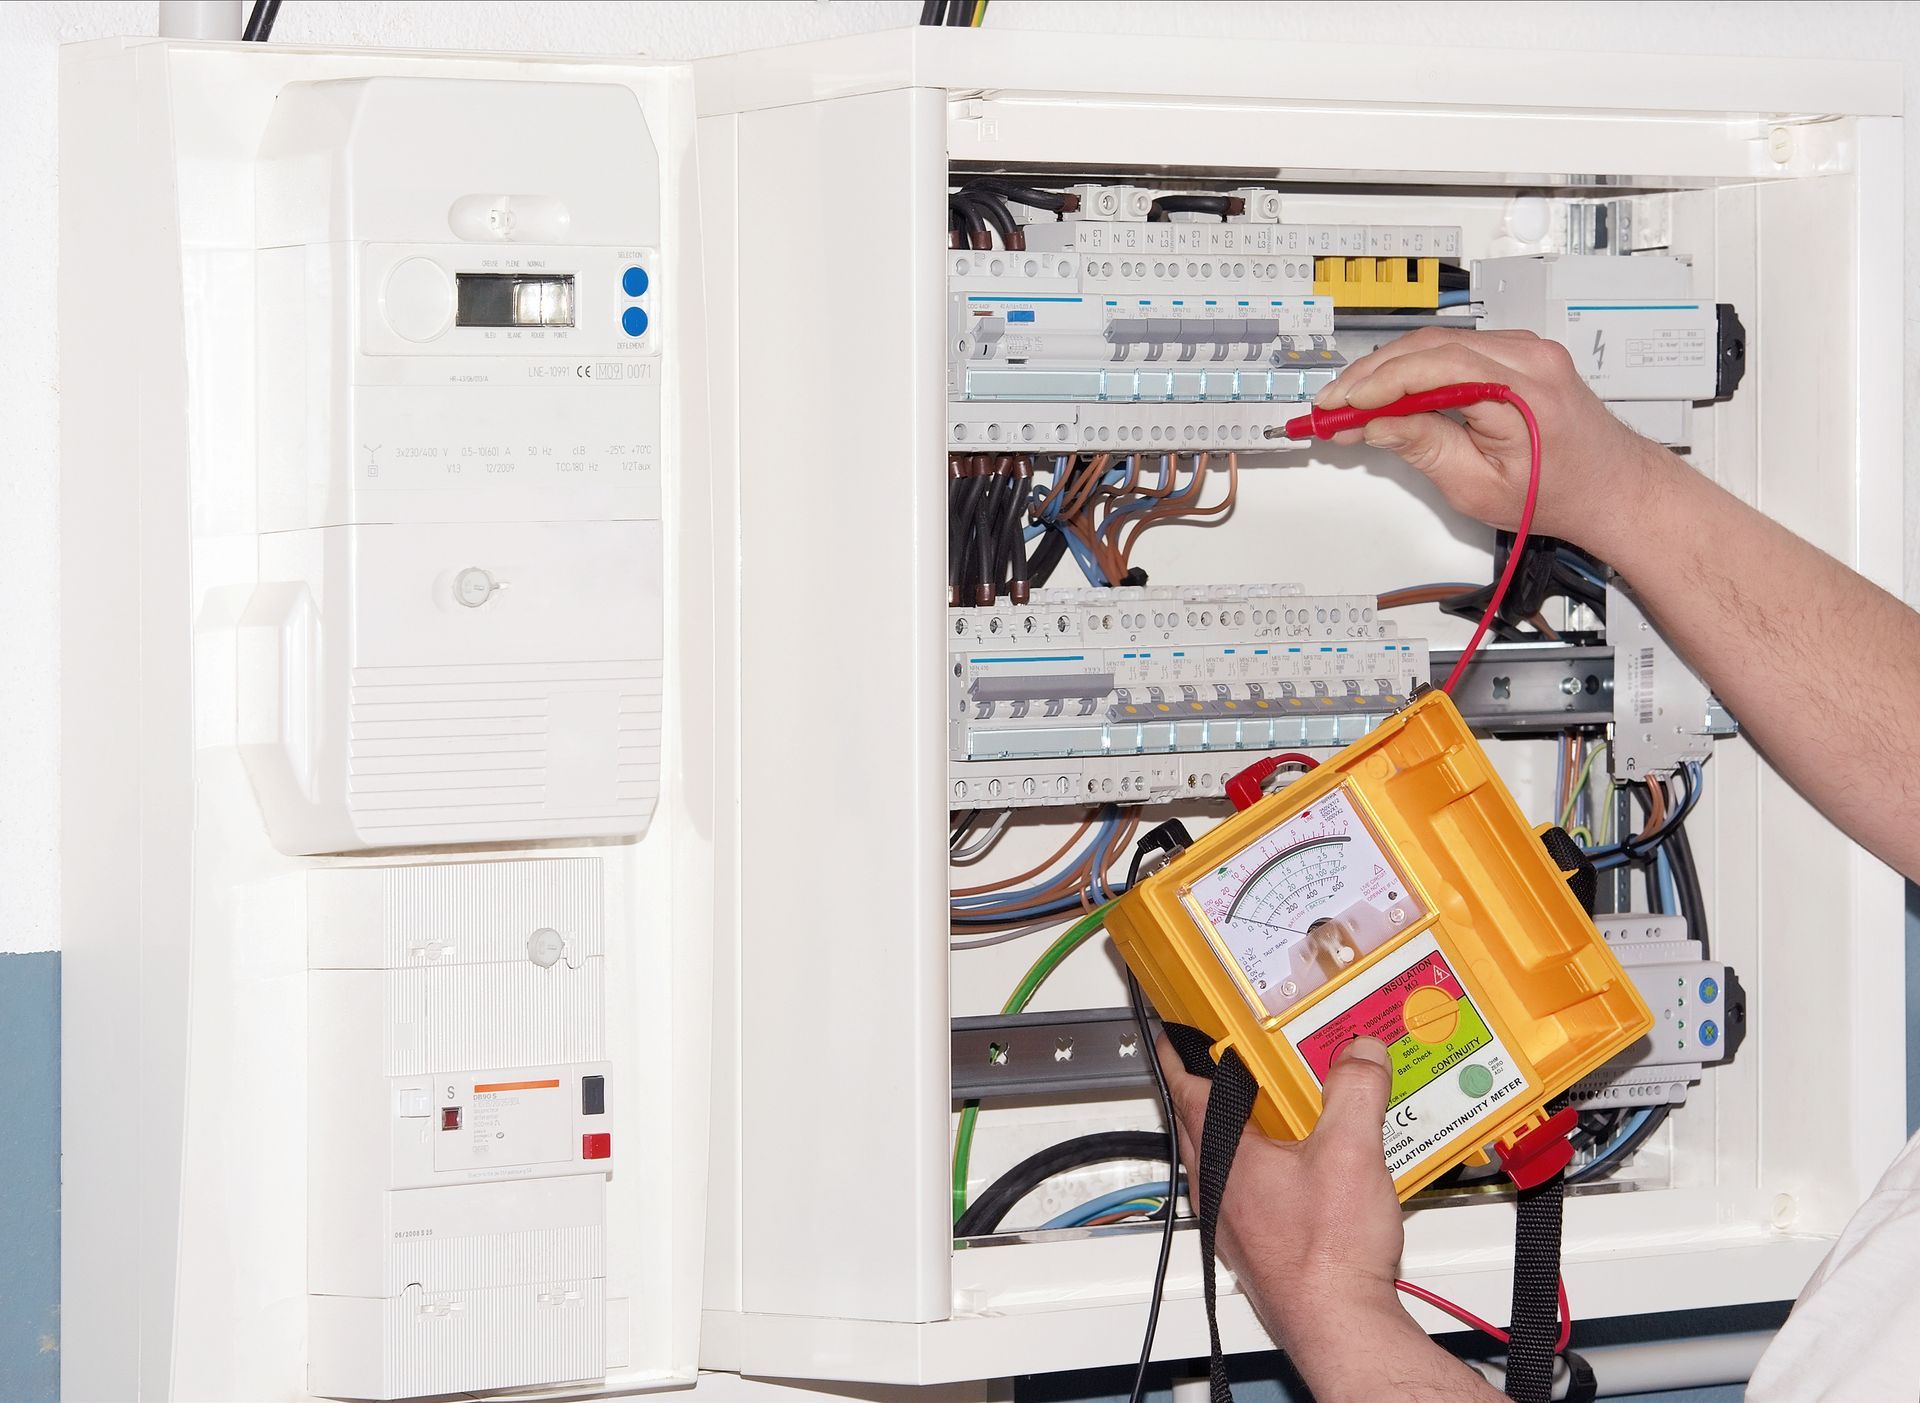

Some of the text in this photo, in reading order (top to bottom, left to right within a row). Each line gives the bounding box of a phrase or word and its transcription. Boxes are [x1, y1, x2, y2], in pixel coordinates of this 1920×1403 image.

[1080, 233, 1086, 243] N
[1093, 239, 1101, 247] L1
[1113, 233, 1120, 243] N
[1147, 234, 1154, 243] N
[1178, 234, 1185, 243] N
[1212, 234, 1218, 244] N
[1244, 235, 1251, 244] N
[1276, 236, 1283, 245] N
[1308, 236, 1315, 245] N
[1340, 237, 1347, 246] N
[1371, 238, 1377, 246] N
[1402, 238, 1408, 247] N
[1433, 239, 1439, 247] N
[1127, 239, 1135, 248] L2
[1160, 240, 1169, 248] L3
[1192, 240, 1200, 248] L1
[1224, 240, 1233, 248] L2
[1289, 241, 1297, 249] L1
[528, 364, 652, 379] LNE-10991 CE M09 0071
[395, 447, 438, 458] 3x230/400
[443, 448, 449, 457] V
[505, 447, 512, 456] A
[528, 447, 539, 456] 50
[542, 447, 553, 456] Hz
[486, 463, 515, 473] 12/2009
[589, 462, 599, 472] Hz
[1231, 872, 1239, 880] 10
[1305, 874, 1314, 882] 50
[1315, 869, 1328, 878] 100
[1220, 886, 1230, 896] 20
[1287, 883, 1296, 892] 20
[1332, 881, 1345, 892] 600
[1276, 893, 1285, 902] 10
[1307, 889, 1318, 900] 400
[1214, 898, 1224, 907] 50
[1286, 903, 1299, 913] 200
[1263, 938, 1288, 957] TAUT BAND
[1382, 958, 1432, 996] INSULATION
[1404, 980, 1419, 993] MΩ
[1363, 1001, 1403, 1030] 1000V/400MΩ
[1402, 1036, 1412, 1046] 3Ω
[1402, 1044, 1420, 1059] 500Ω
[1446, 1043, 1454, 1052] Ω
[1431, 1036, 1480, 1075] CONTINUITY
[1397, 1050, 1432, 1076] Batt. Check
[1487, 1056, 1499, 1066] OHM
[1490, 1060, 1504, 1071] ZERO
[1494, 1067, 1504, 1076] ADJ
[447, 1085, 455, 1100] S
[1490, 1077, 1523, 1103] METER
[1396, 1105, 1418, 1127] CE
[1384, 1136, 1414, 1161] 9050A
